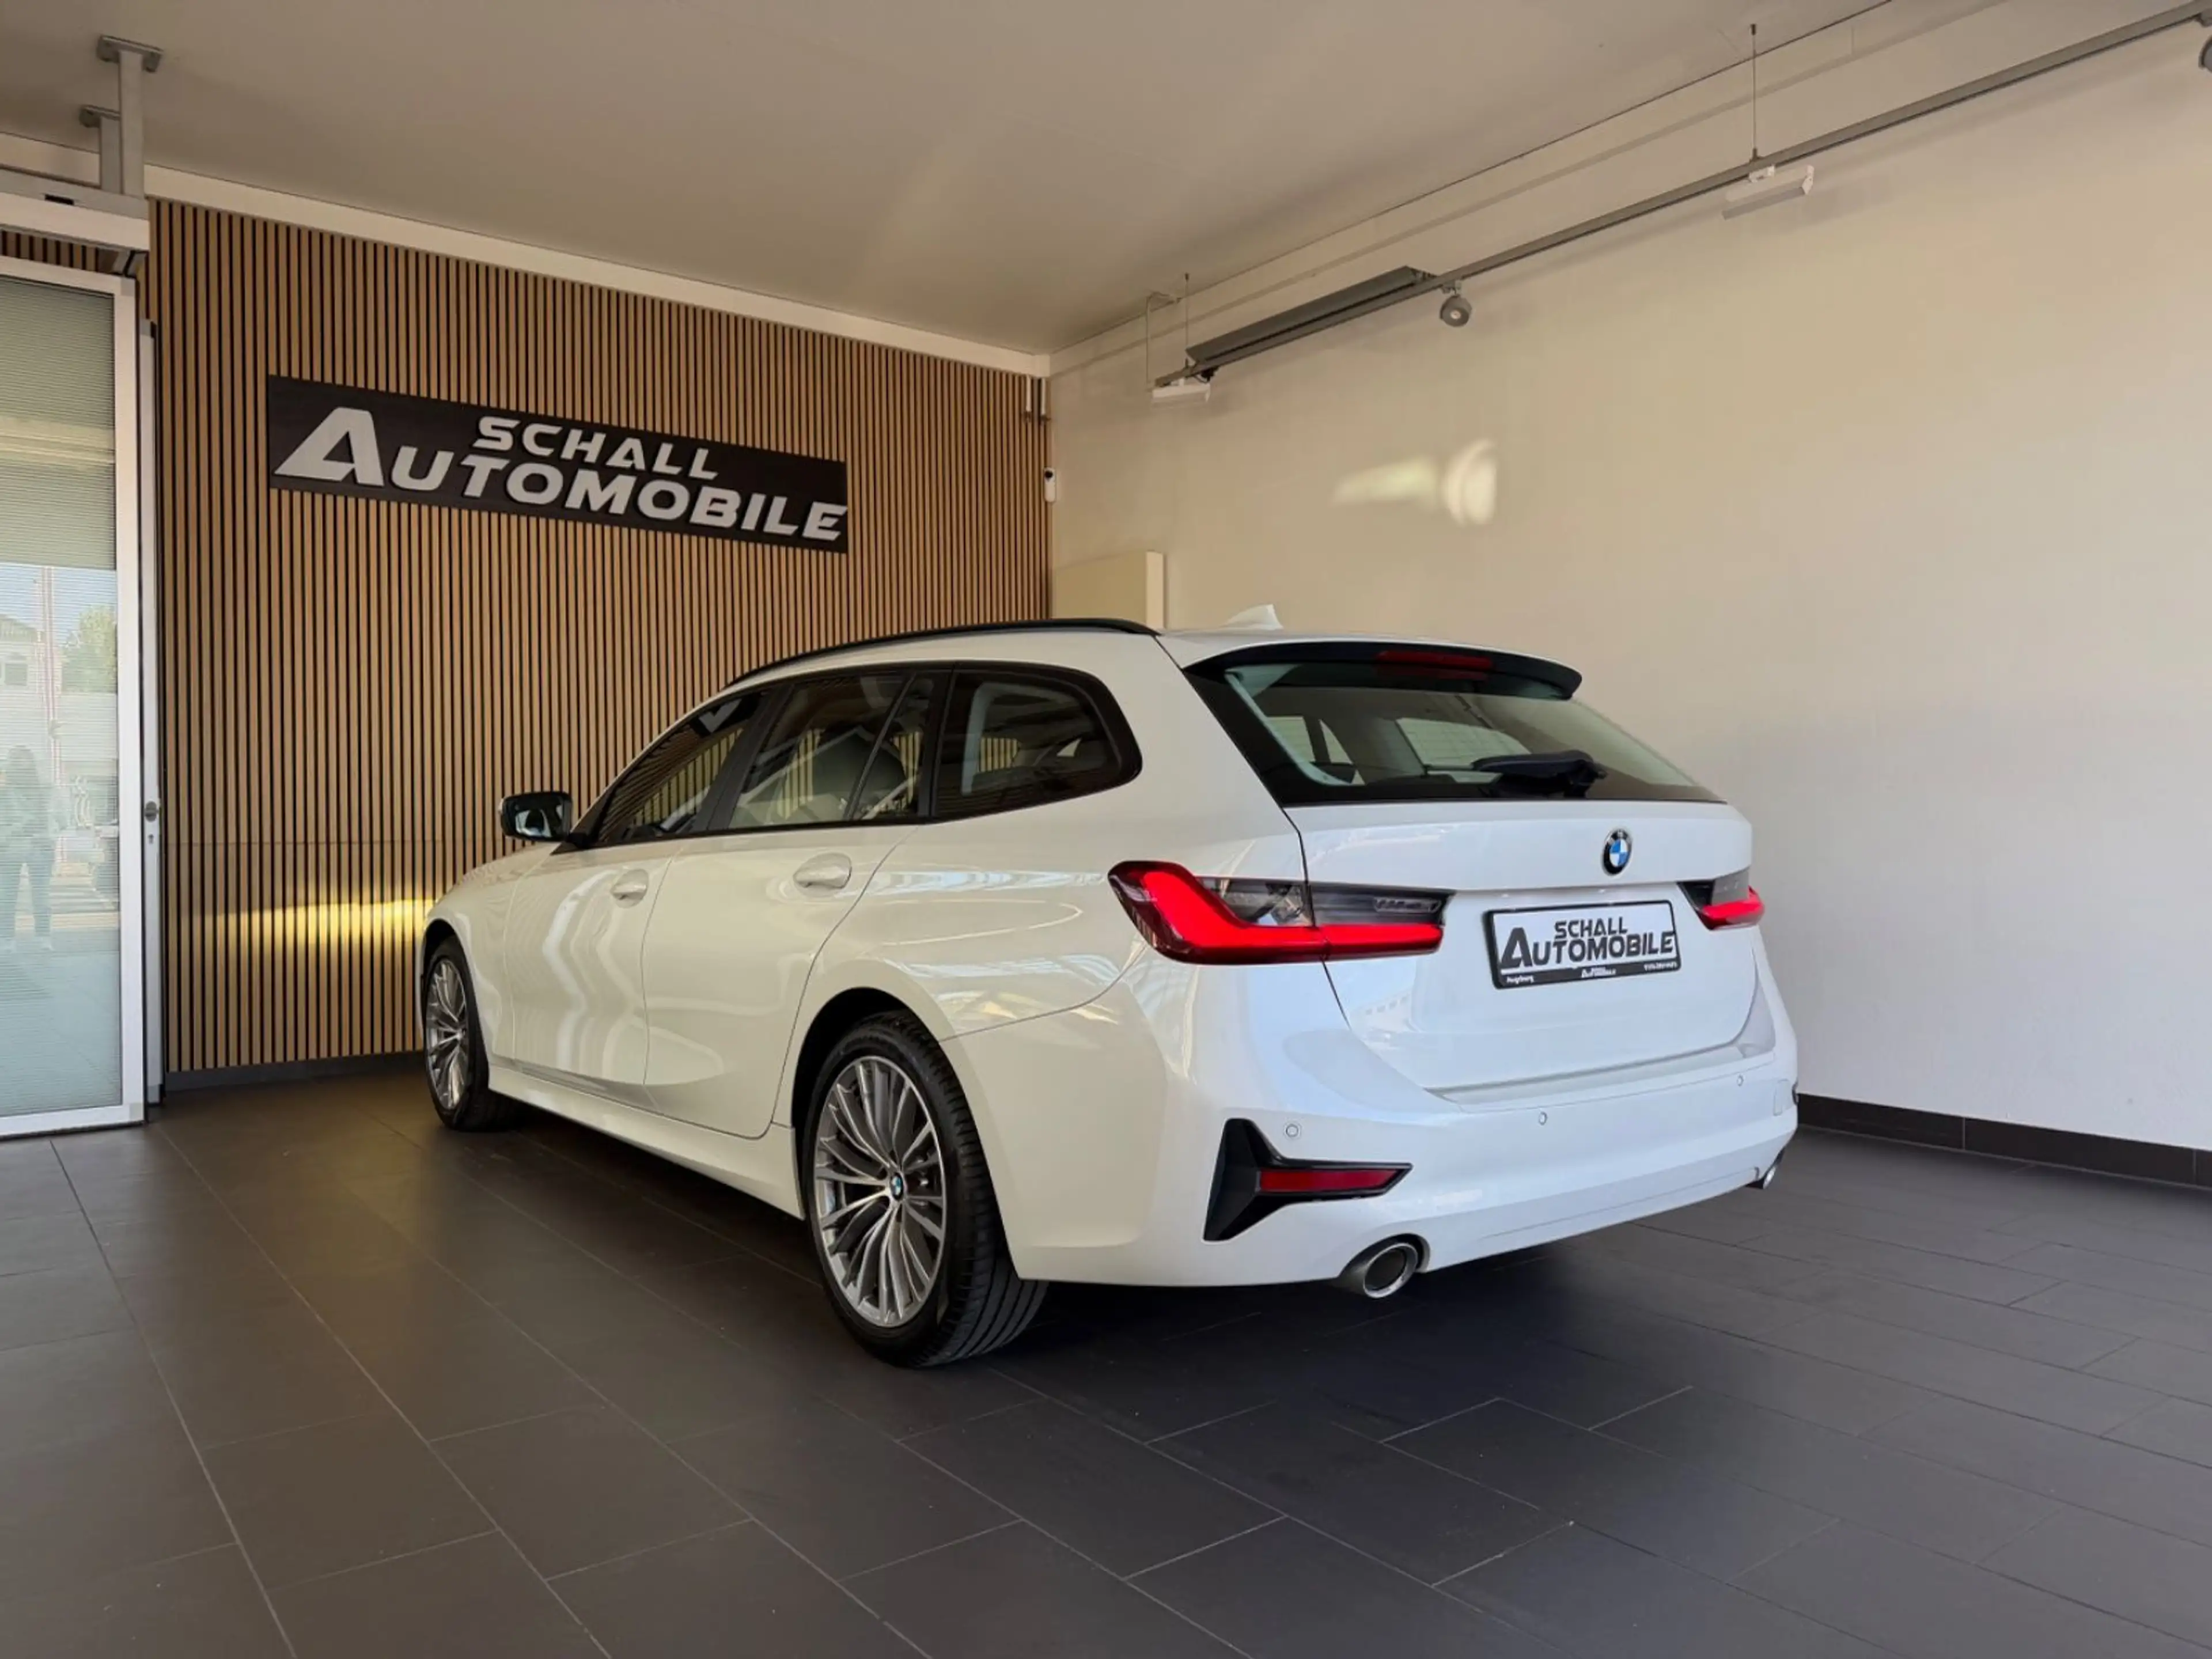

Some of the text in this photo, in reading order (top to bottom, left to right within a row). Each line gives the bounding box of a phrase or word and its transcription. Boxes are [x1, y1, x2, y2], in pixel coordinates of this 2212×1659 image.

[274, 407, 849, 540] AUTOMOBILE
[473, 416, 717, 480] SCHALL
[1501, 927, 1675, 967] AUTOMOBILE
[1554, 916, 1628, 940] SCHALL
